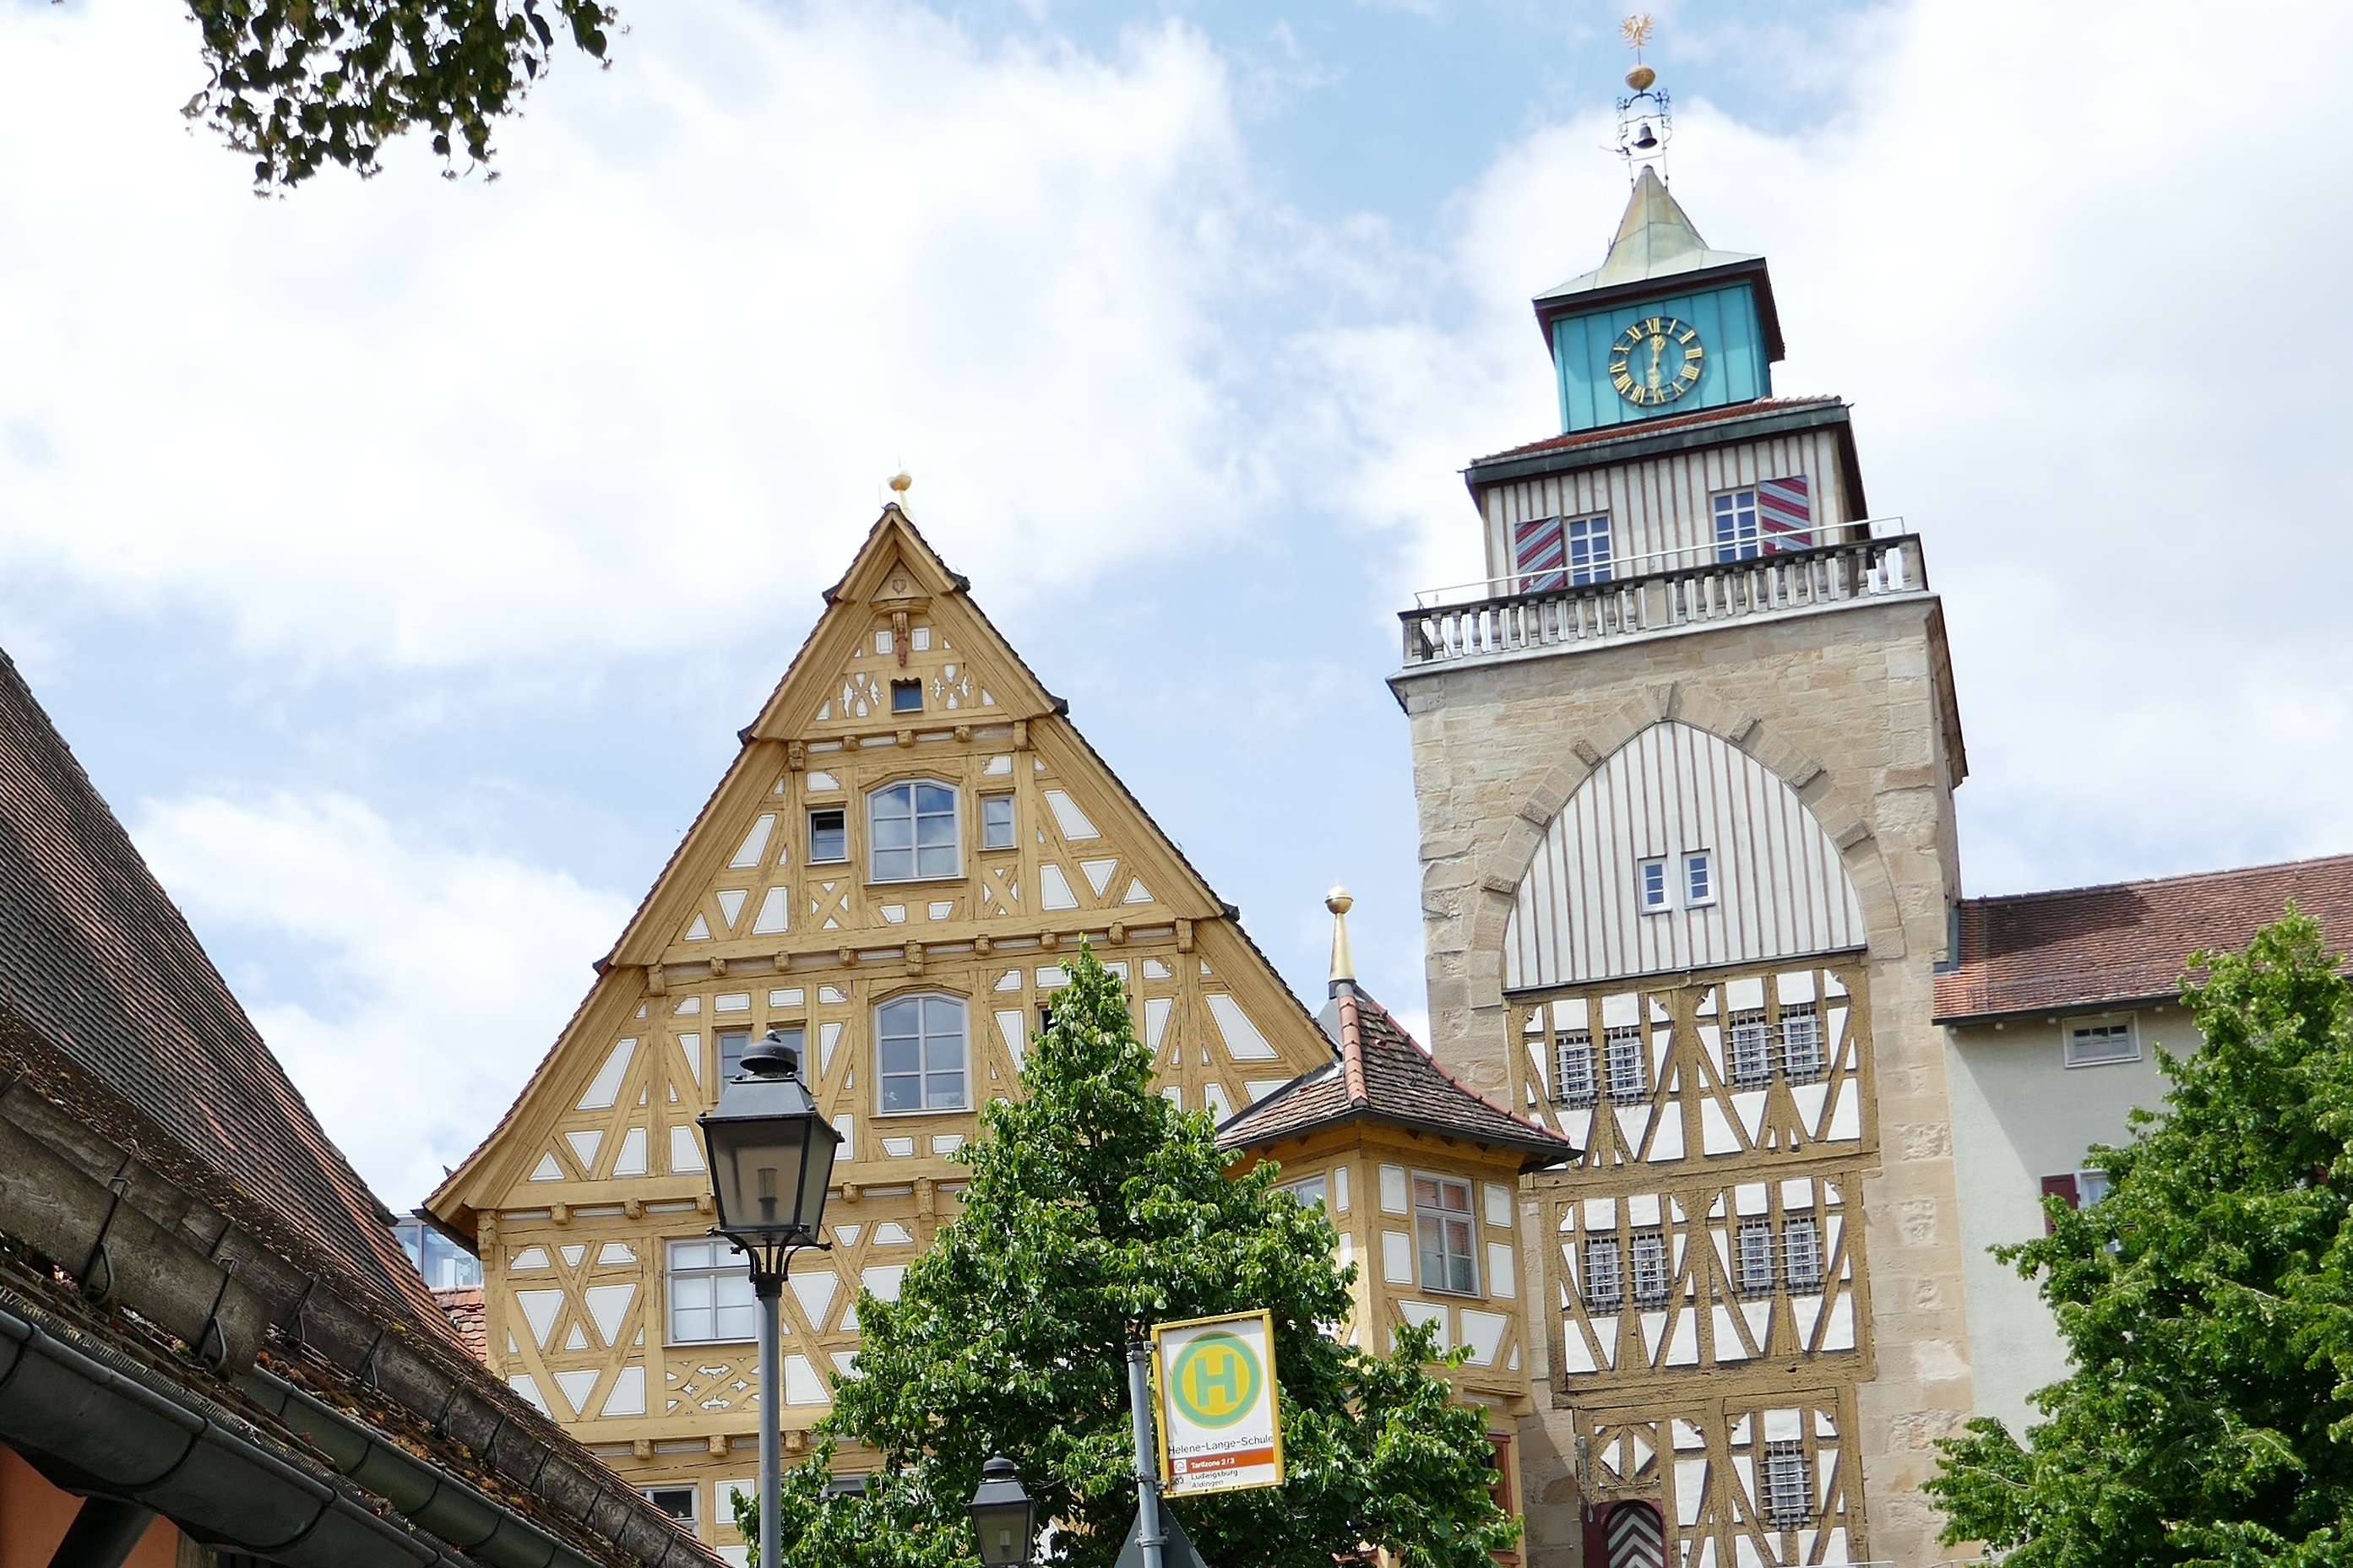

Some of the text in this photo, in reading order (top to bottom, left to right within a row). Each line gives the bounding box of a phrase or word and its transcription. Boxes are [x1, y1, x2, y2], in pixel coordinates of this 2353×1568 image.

[1645, 317, 1660, 334] XII
[1667, 318, 1677, 334] I
[1679, 329, 1696, 345] II
[1613, 343, 1630, 355] X
[1685, 347, 1703, 360] III
[1680, 364, 1700, 381] IIII
[1193, 1353, 1238, 1408] H
[1168, 1435, 1274, 1455] Helene-Lange-Schule
[1190, 1460, 1220, 1469] Tarifzone
[1191, 1469, 1238, 1481] Ludwigsburg
[1192, 1479, 1224, 1489] Aldingen
